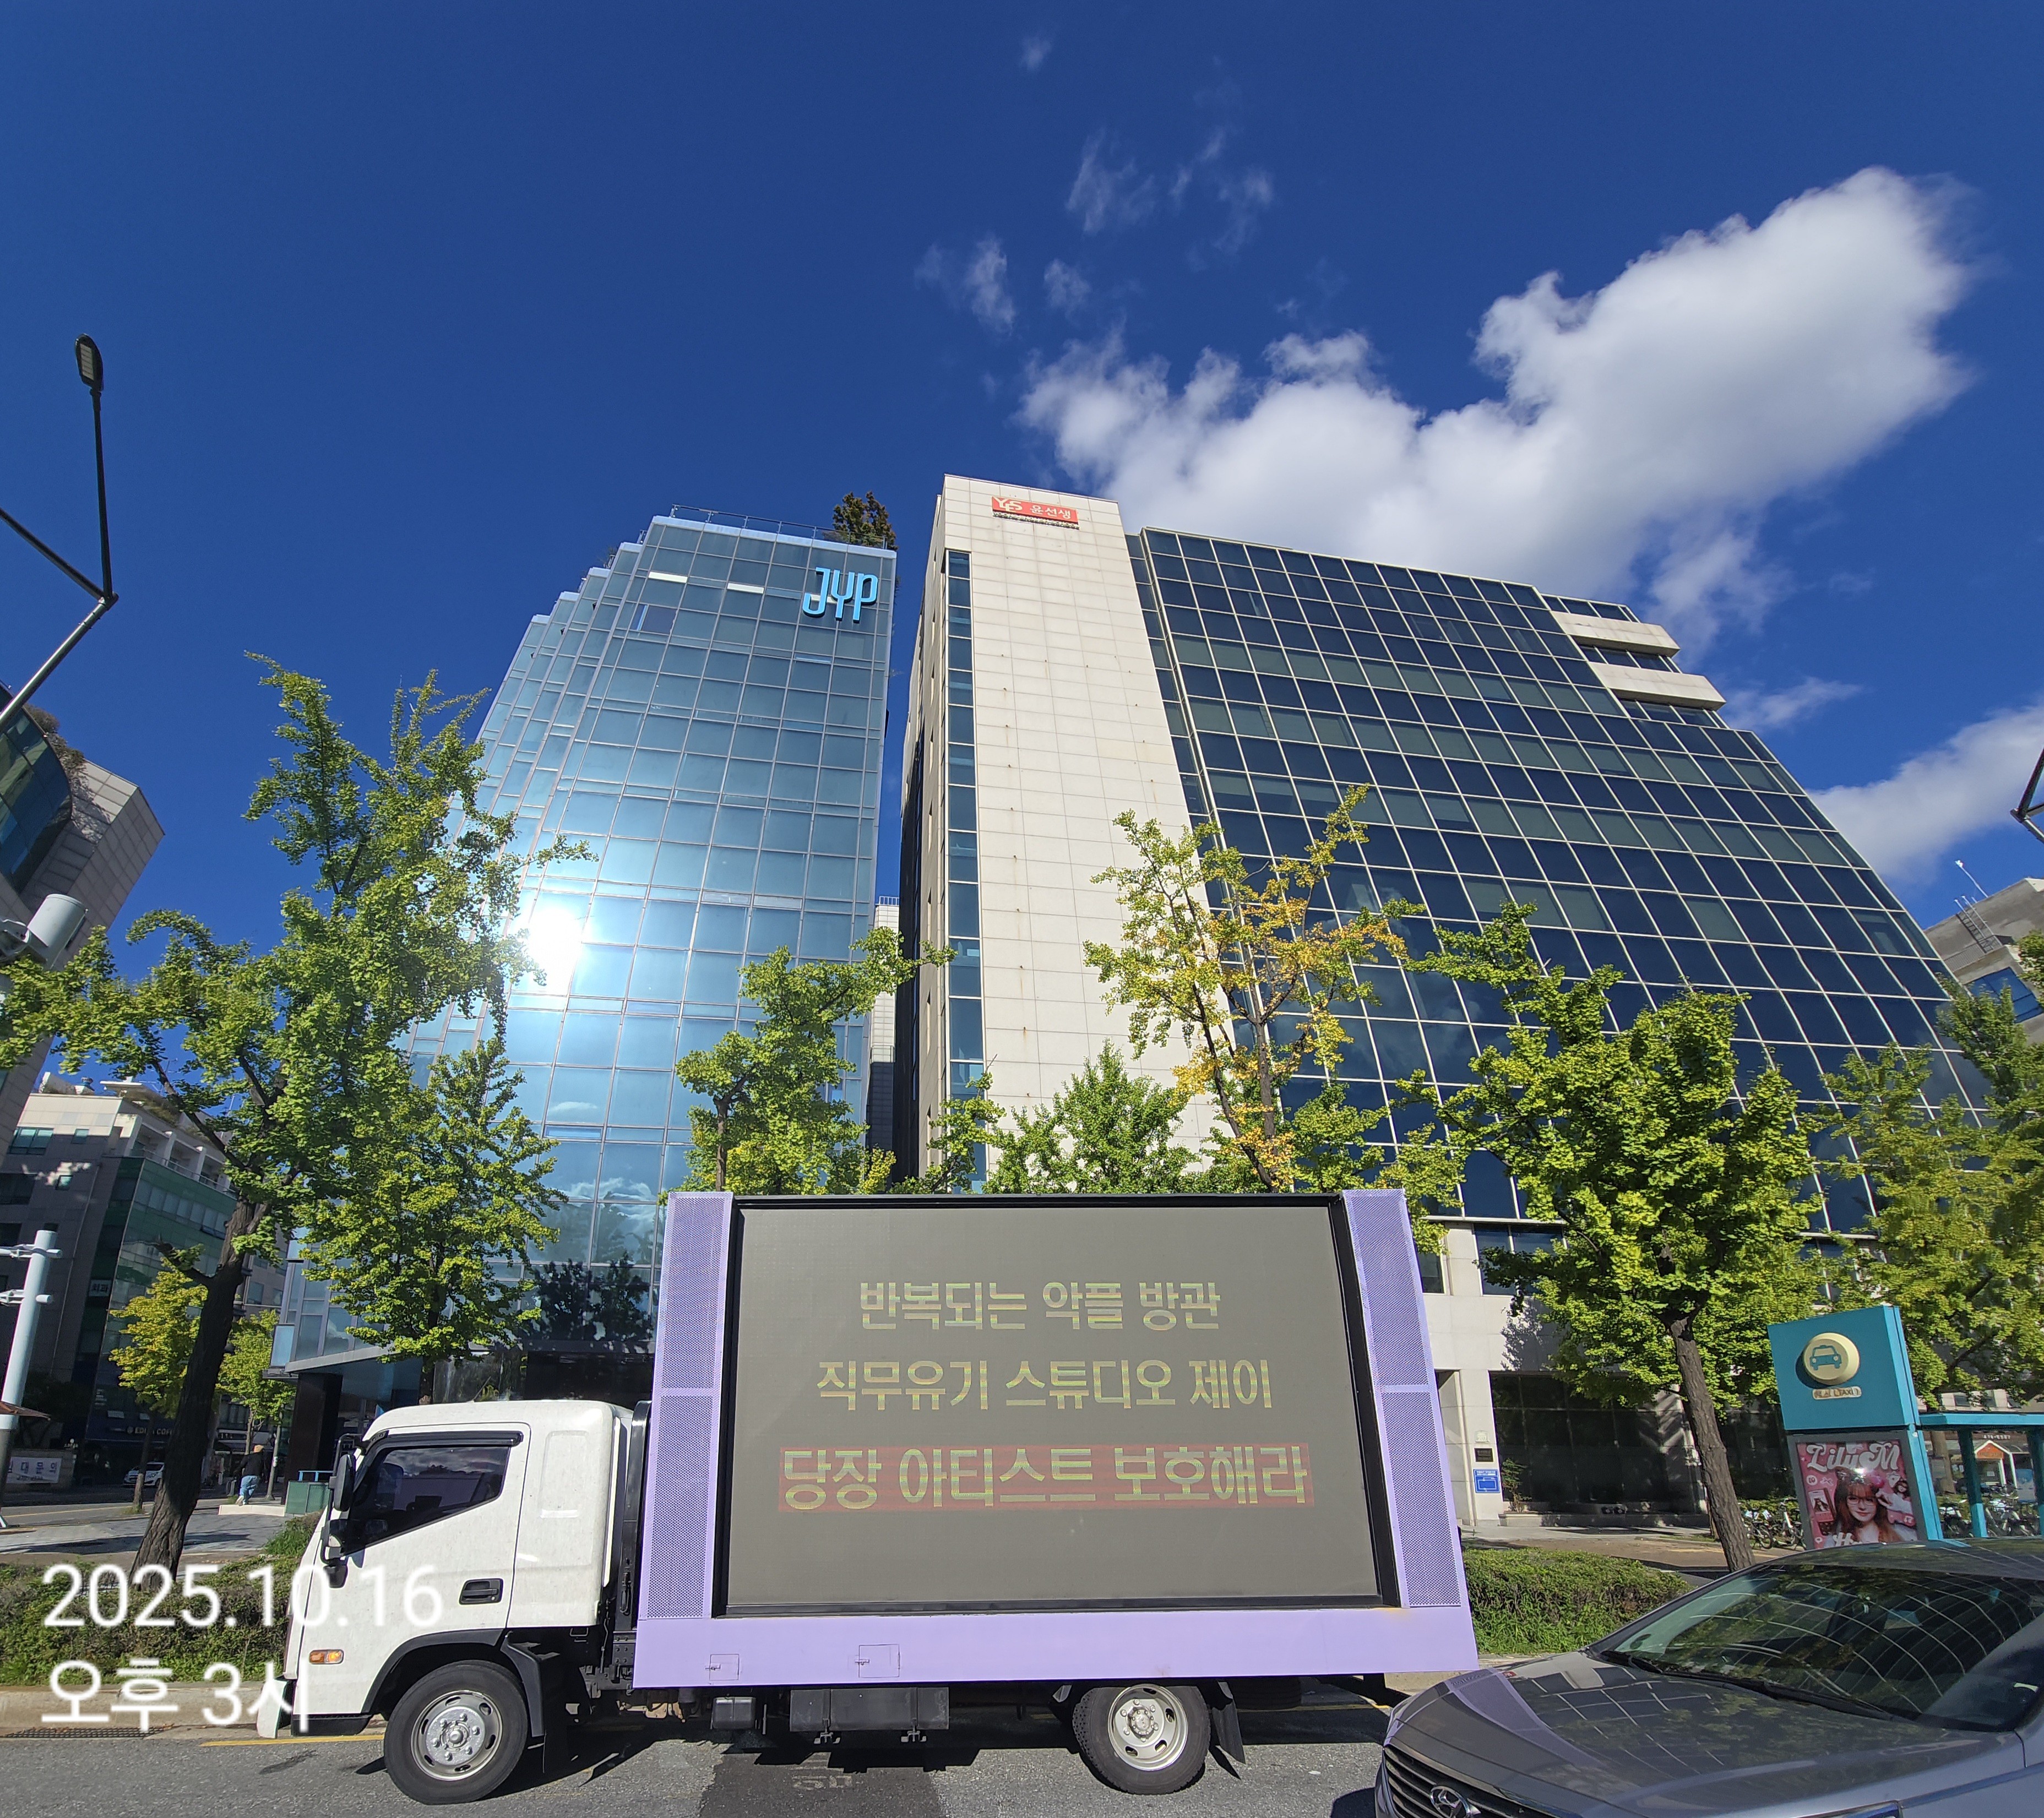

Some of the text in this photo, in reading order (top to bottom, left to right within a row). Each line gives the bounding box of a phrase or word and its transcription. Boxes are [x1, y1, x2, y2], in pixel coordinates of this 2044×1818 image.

[1030, 505, 1072, 520] 윤선생
[802, 567, 878, 622] JYP
[860, 1281, 1221, 1331] 반복되는 악플 방관
[817, 1359, 1273, 1411] 직무유기 스튜디오 제이
[783, 1446, 1308, 1510] 당장 아티스트 보호해라
